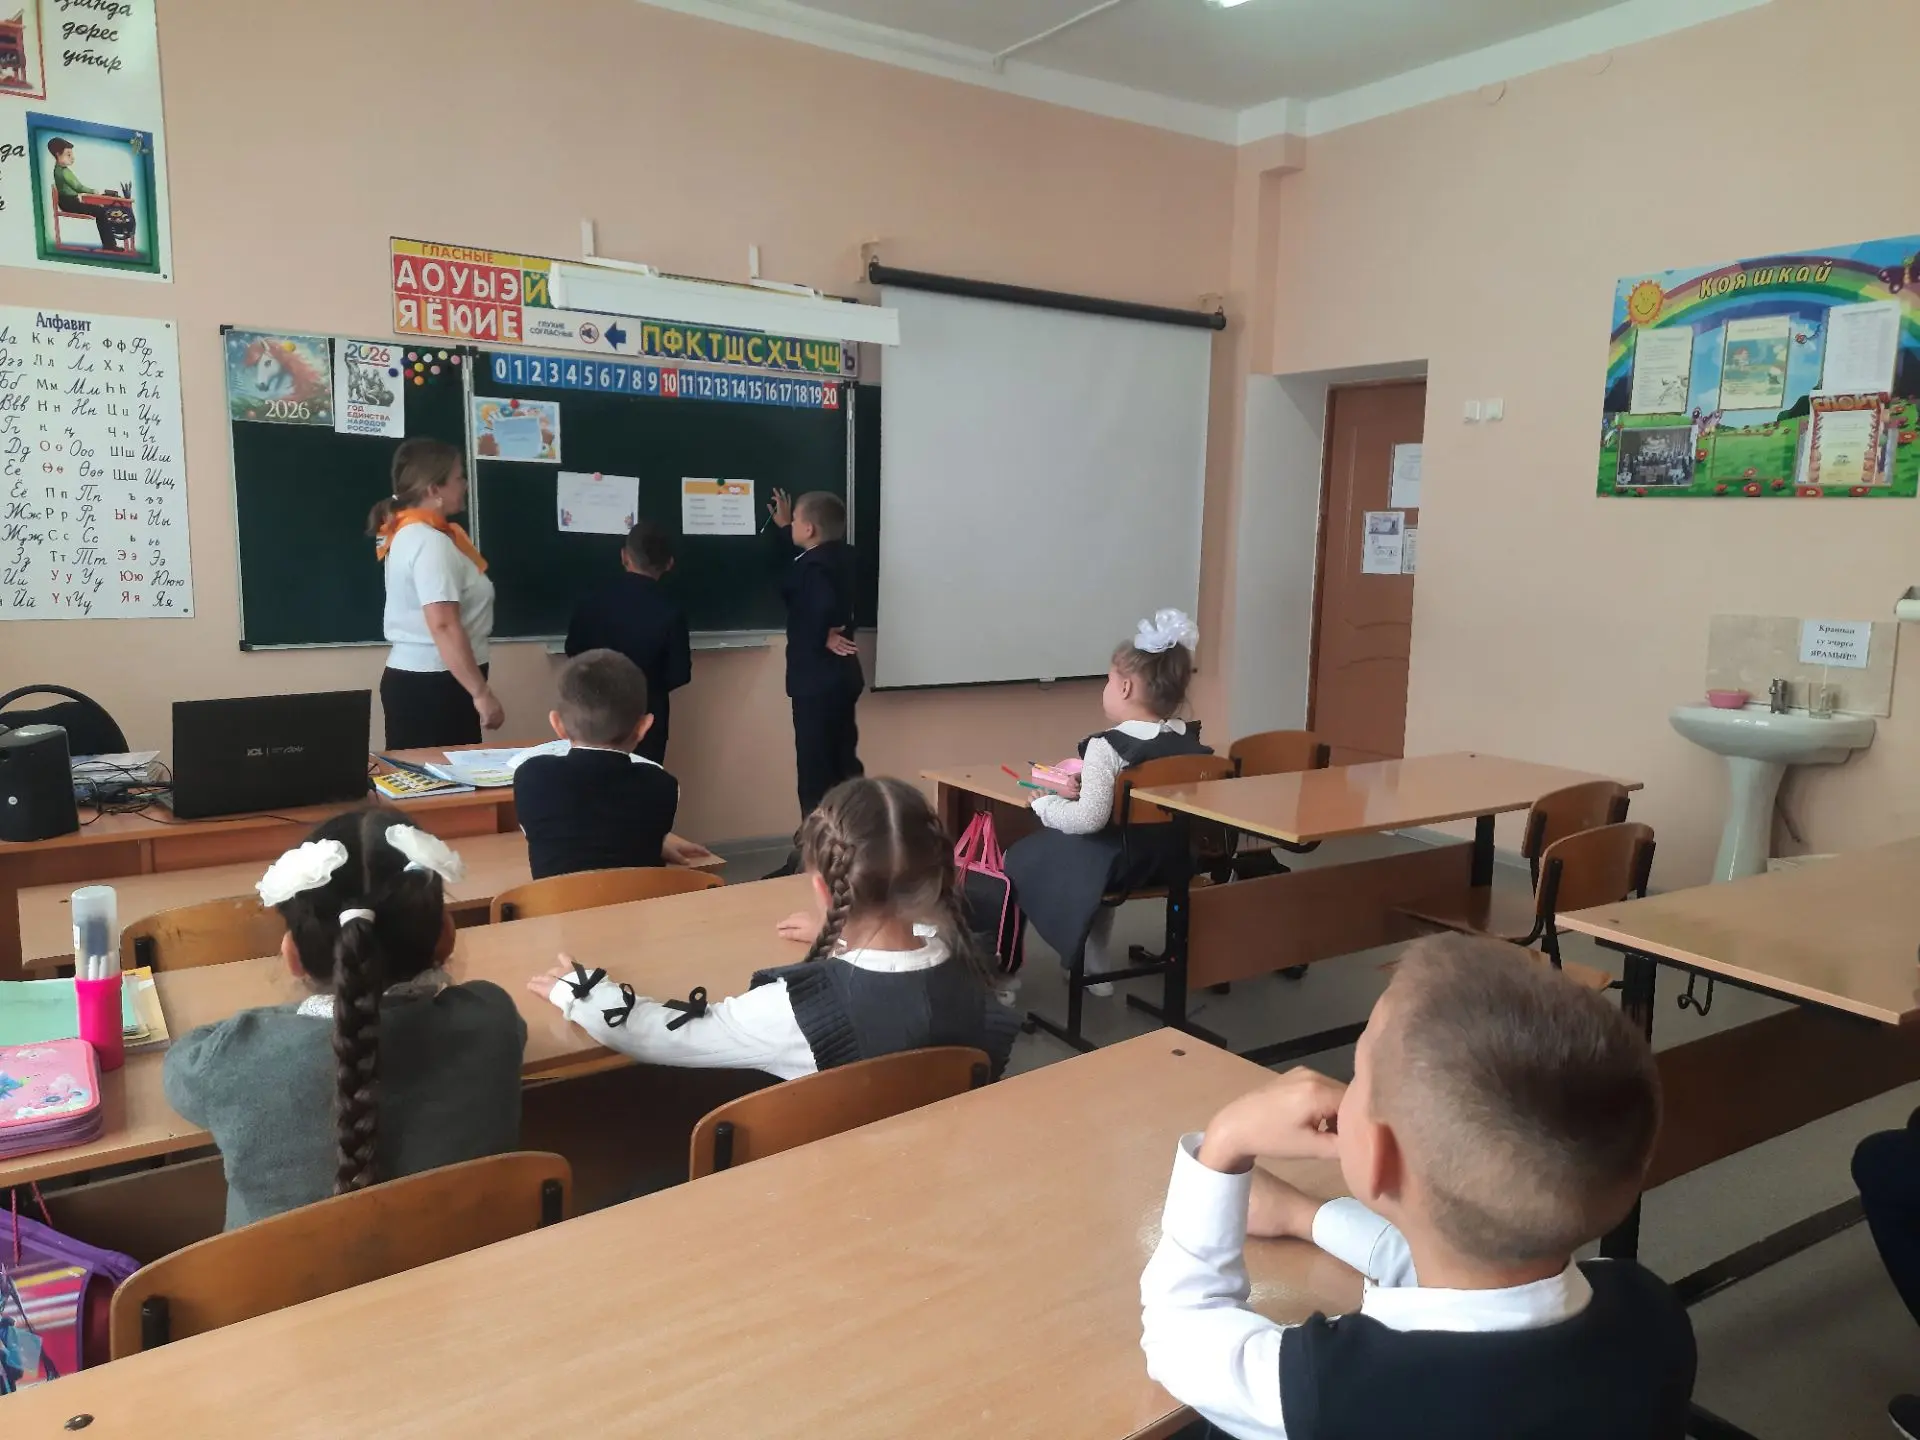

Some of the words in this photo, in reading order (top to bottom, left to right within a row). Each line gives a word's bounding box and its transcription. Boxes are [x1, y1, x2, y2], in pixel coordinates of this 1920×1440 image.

[0, 143, 26, 163] да
[421, 243, 494, 263] ГЛАСНЫЕ
[36, 311, 91, 332] Алфавит
[495, 358, 506, 379] 0
[516, 360, 523, 380] 1
[531, 361, 542, 382] 2
[549, 362, 559, 383] 3
[566, 364, 577, 384] 4
[584, 366, 593, 385] 5
[600, 368, 610, 387] 6
[616, 369, 625, 388] 7
[632, 370, 642, 390] 8
[648, 372, 657, 391] 9
[662, 373, 676, 394] 10
[680, 374, 694, 394] 11
[698, 376, 711, 396] 12
[715, 378, 728, 397] 13
[732, 379, 746, 399] 14
[749, 380, 762, 400] 15
[765, 382, 777, 401] 16
[779, 383, 792, 403] 17
[795, 384, 807, 404] 18
[809, 385, 822, 405] 19
[823, 386, 837, 406] 20
[265, 399, 310, 420] 2026
[347, 404, 364, 412] ГОД
[347, 411, 391, 421] ЕДИНСТВА
[347, 424, 382, 433] РОССИИ
